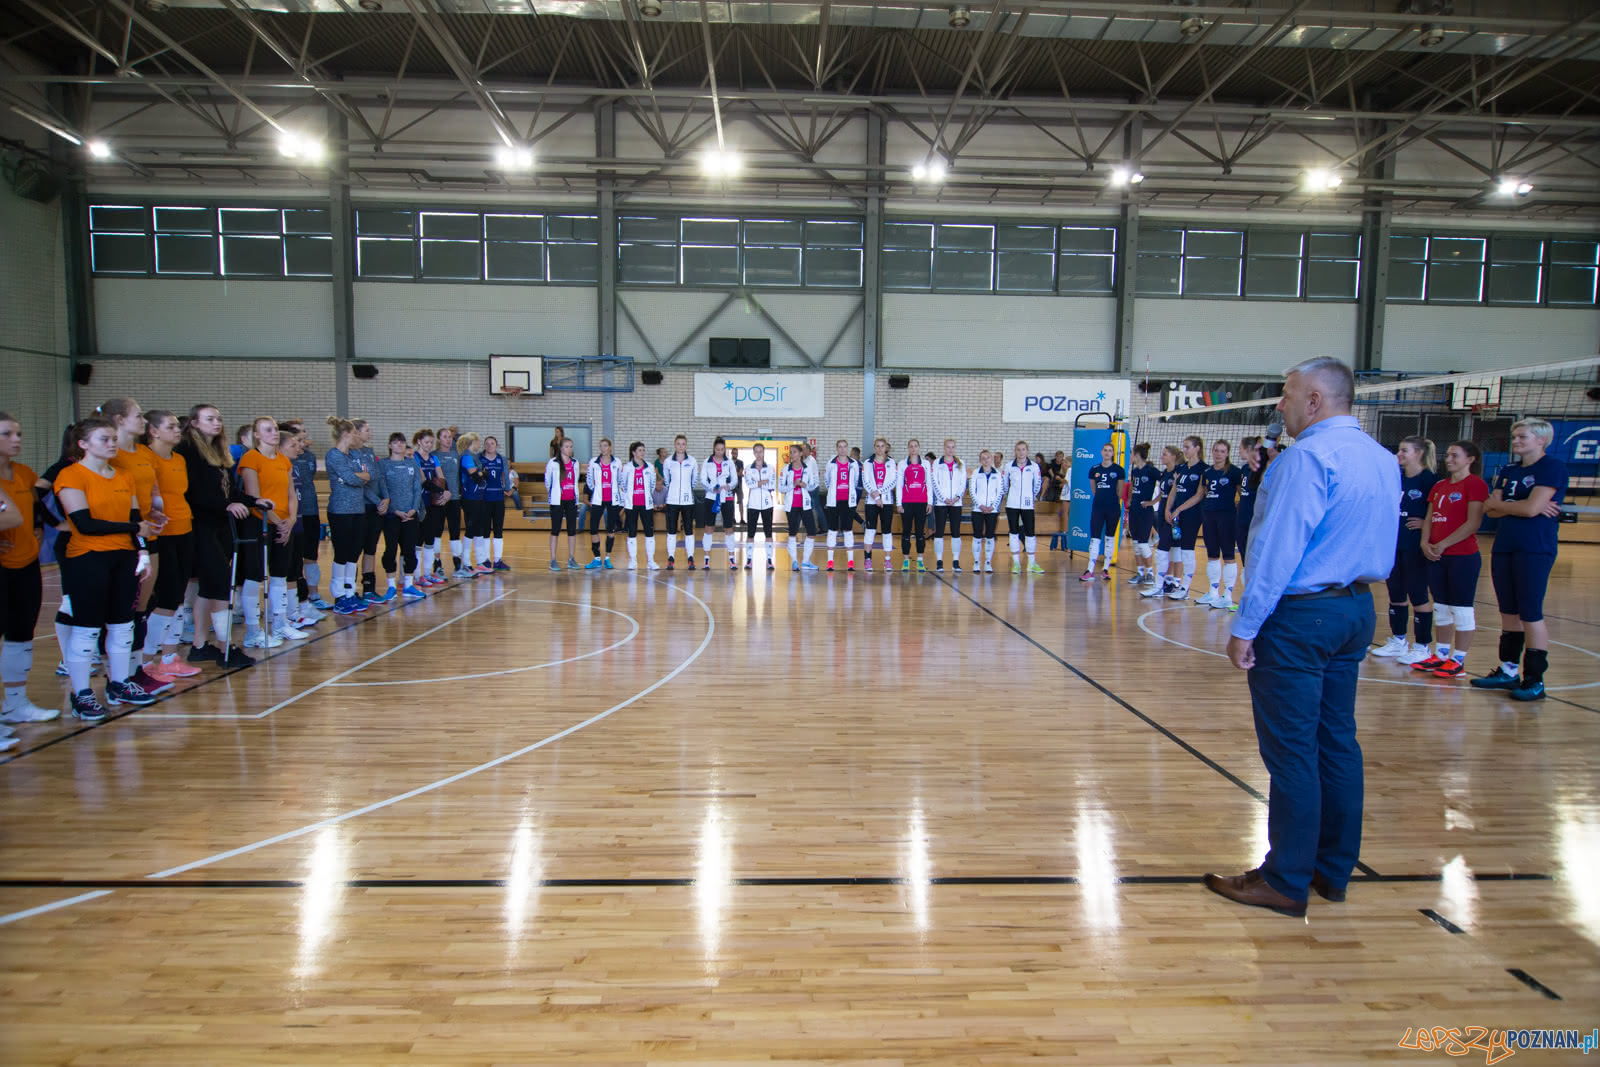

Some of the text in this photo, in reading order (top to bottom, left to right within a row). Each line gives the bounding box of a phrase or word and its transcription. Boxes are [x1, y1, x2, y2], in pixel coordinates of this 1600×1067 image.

[1025, 396, 1101, 412] POZnan
[603, 471, 608, 480] 9
[840, 471, 847, 480] 15
[877, 470, 884, 480] 12
[913, 470, 918, 479] 7
[1101, 473, 1107, 481] 5
[636, 477, 643, 486] 14
[1210, 480, 1217, 490] 2
[1508, 480, 1518, 496] 3
[1438, 494, 1446, 509] 1
